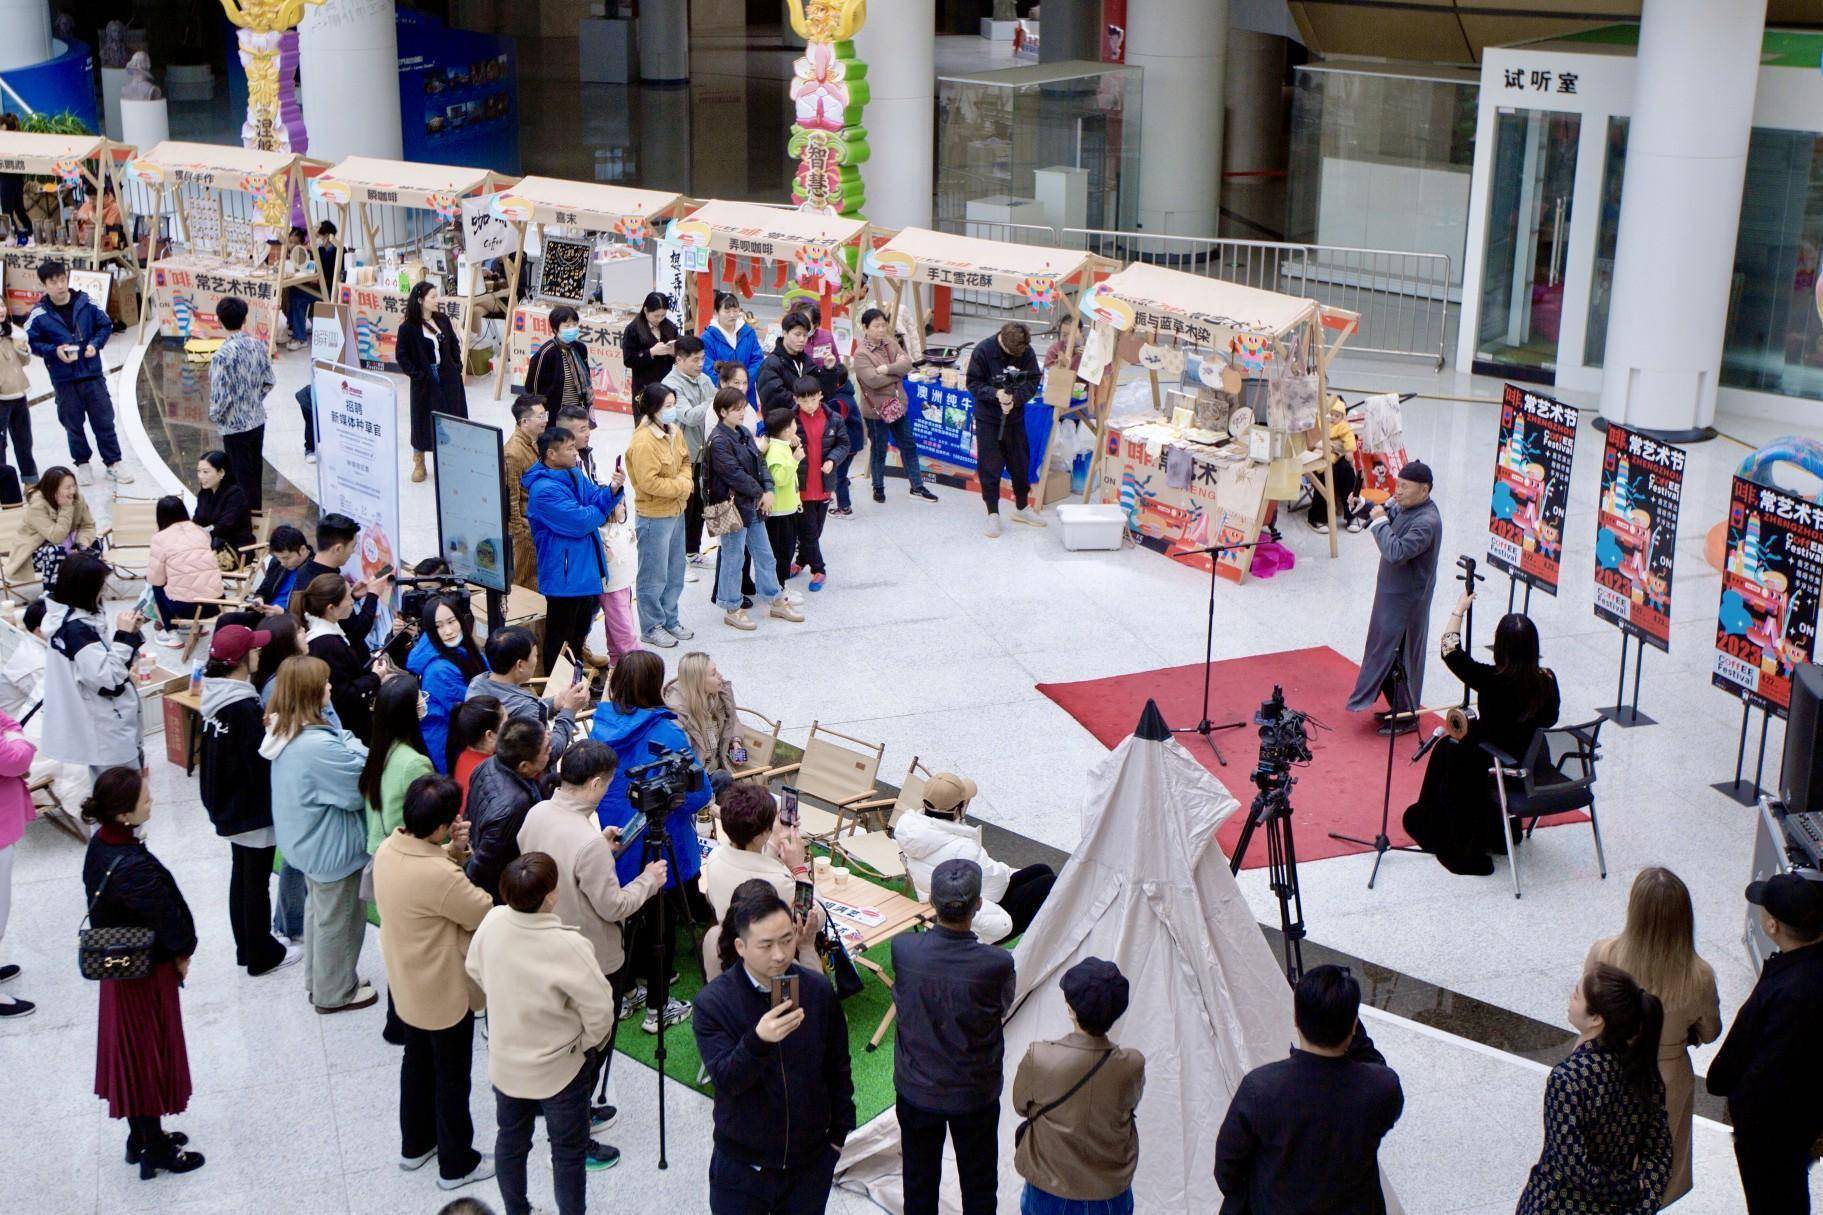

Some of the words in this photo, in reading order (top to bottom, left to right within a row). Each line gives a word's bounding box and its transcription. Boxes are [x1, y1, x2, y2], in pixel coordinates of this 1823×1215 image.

[1504, 68, 1578, 94] 试听室
[808, 143, 828, 197] 智慧
[729, 238, 774, 256] 弄呗咖啡
[927, 267, 992, 287] 手工雪花酥
[346, 400, 363, 416] 招聘
[331, 410, 382, 438] 新媒体种草官
[1543, 439, 1573, 455] Festival
[1103, 476, 1116, 485] ON
[1648, 482, 1680, 502] Festival
[1553, 506, 1565, 518] ON
[1490, 515, 1524, 547] 2023
[1490, 544, 1517, 562] Festival
[1660, 555, 1672, 569] ON
[1595, 566, 1632, 597] 2023
[1598, 594, 1626, 615] Festival
[1799, 622, 1814, 637] ON
[1716, 630, 1761, 668] 2023
[1718, 662, 1753, 687] Festival
